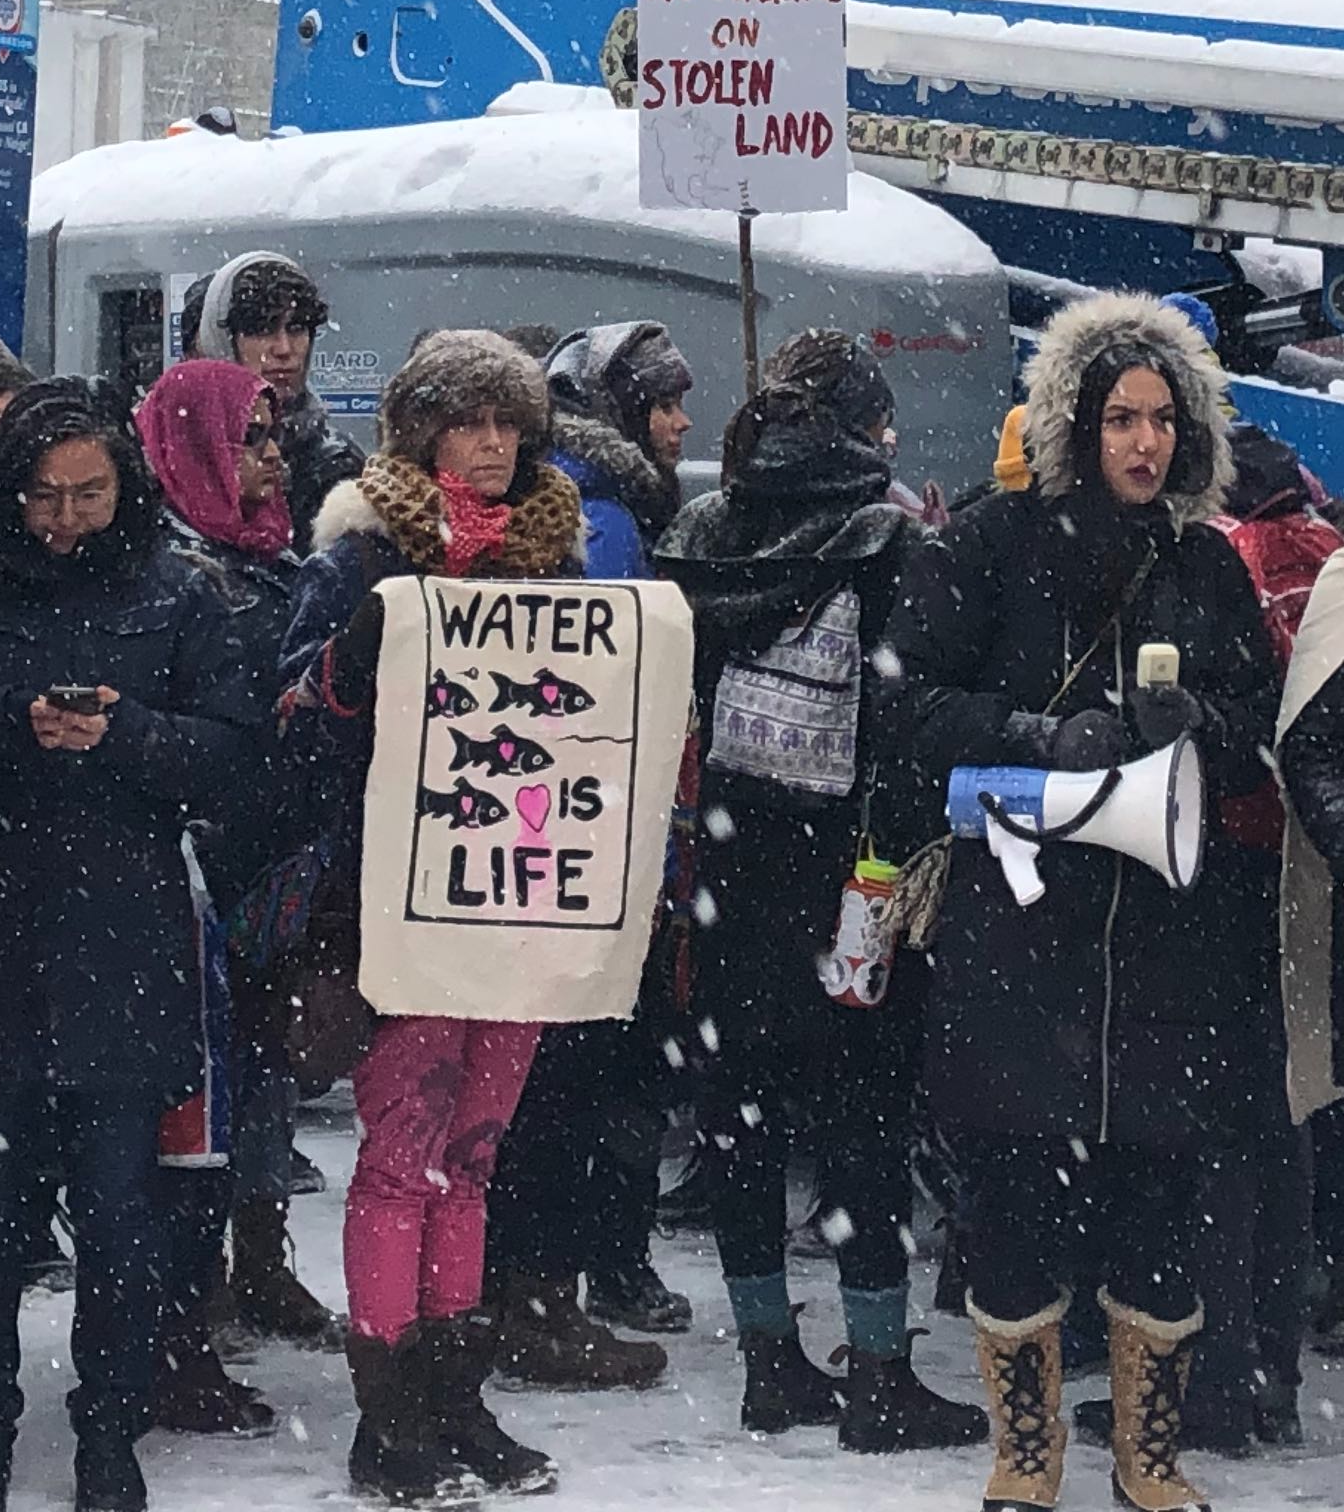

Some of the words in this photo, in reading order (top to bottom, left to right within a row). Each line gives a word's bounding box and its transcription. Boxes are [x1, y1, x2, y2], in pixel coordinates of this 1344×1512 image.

[711, 17, 760, 49] ON
[642, 58, 775, 110] STOLEN
[735, 110, 835, 159] LAND
[435, 587, 618, 656] WATER
[558, 775, 604, 822] IS
[446, 844, 595, 911] LIFE
